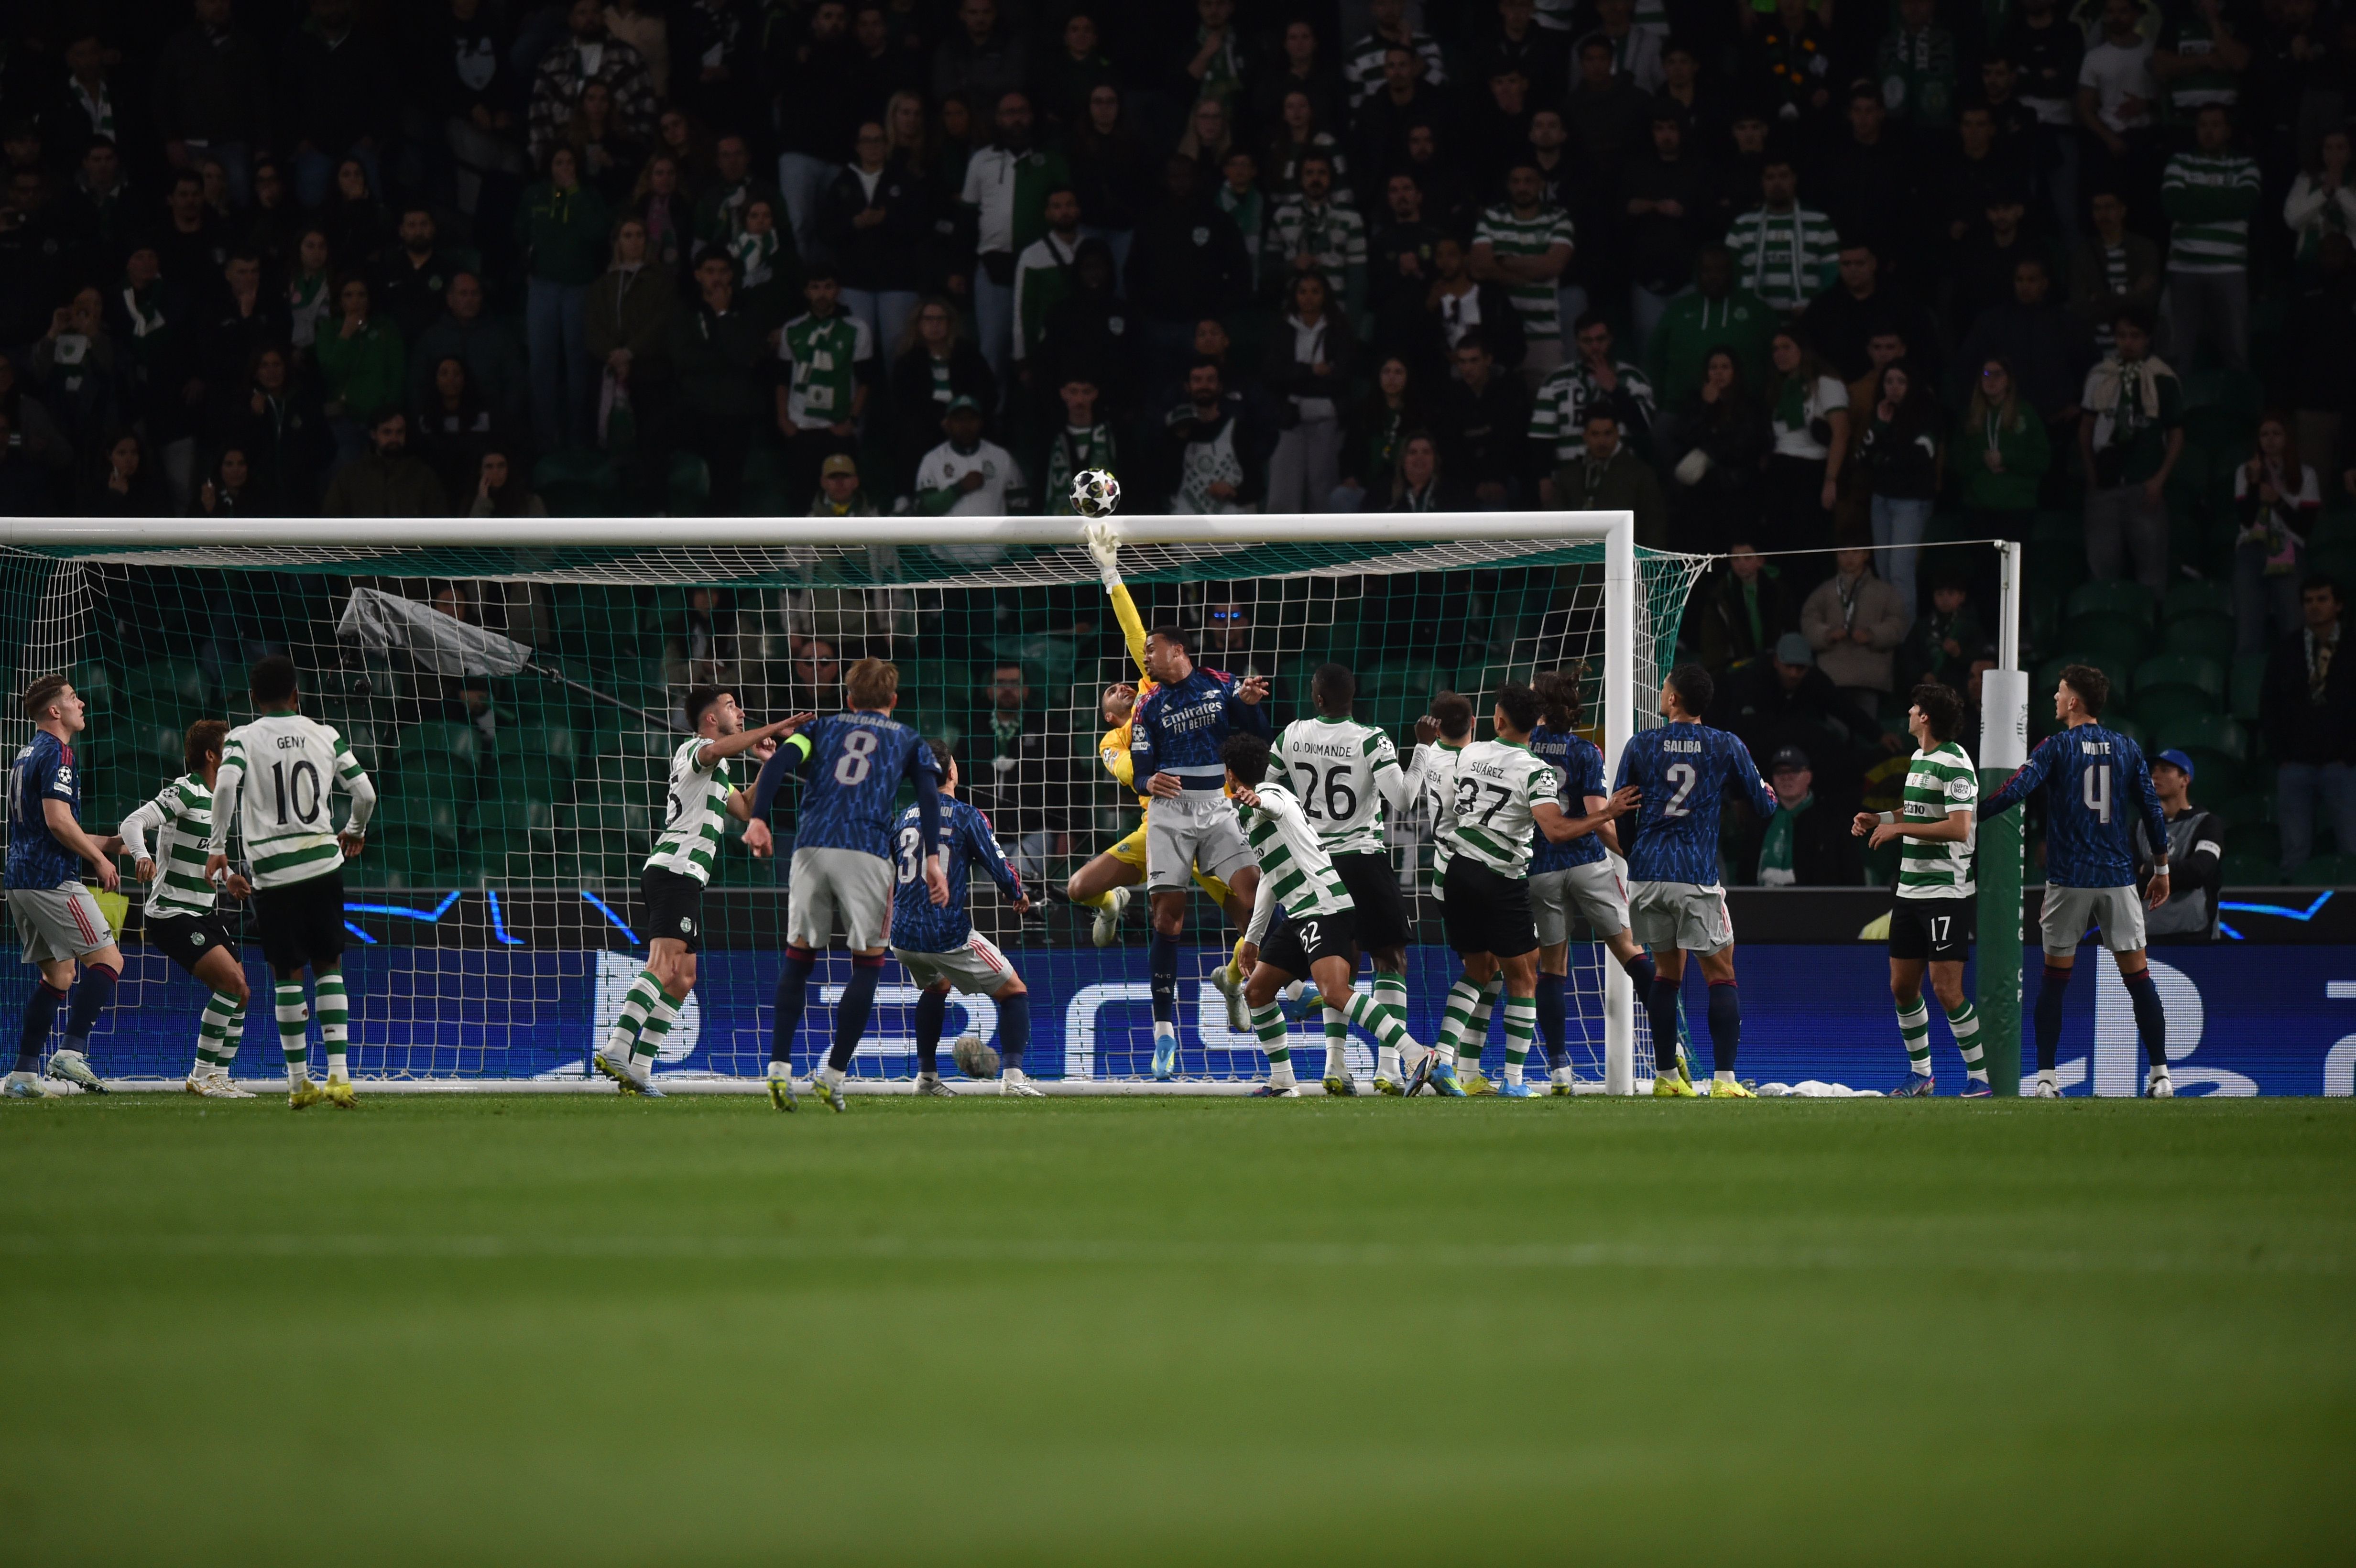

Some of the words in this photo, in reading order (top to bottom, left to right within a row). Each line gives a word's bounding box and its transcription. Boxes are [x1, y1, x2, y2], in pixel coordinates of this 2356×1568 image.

[1161, 701, 1222, 729] Emirates
[1174, 722, 1187, 735] FLY
[1189, 713, 1216, 730] BETTER
[277, 736, 306, 749] GENY
[1304, 742, 1352, 757] DIOMANDE
[1663, 740, 1701, 753] SALIBA
[2082, 741, 2111, 755] WHITE
[834, 730, 878, 785] 8
[1471, 762, 1504, 779] SUÁREZ
[272, 760, 320, 825] 10
[1294, 762, 1356, 821] 26
[1664, 763, 1695, 817] 2
[2084, 765, 2110, 823] 4
[1904, 802, 1925, 814] etano
[2017, 804, 2025, 941] PORTING
[1299, 921, 1321, 952] 52
[1931, 916, 1951, 941] 17
